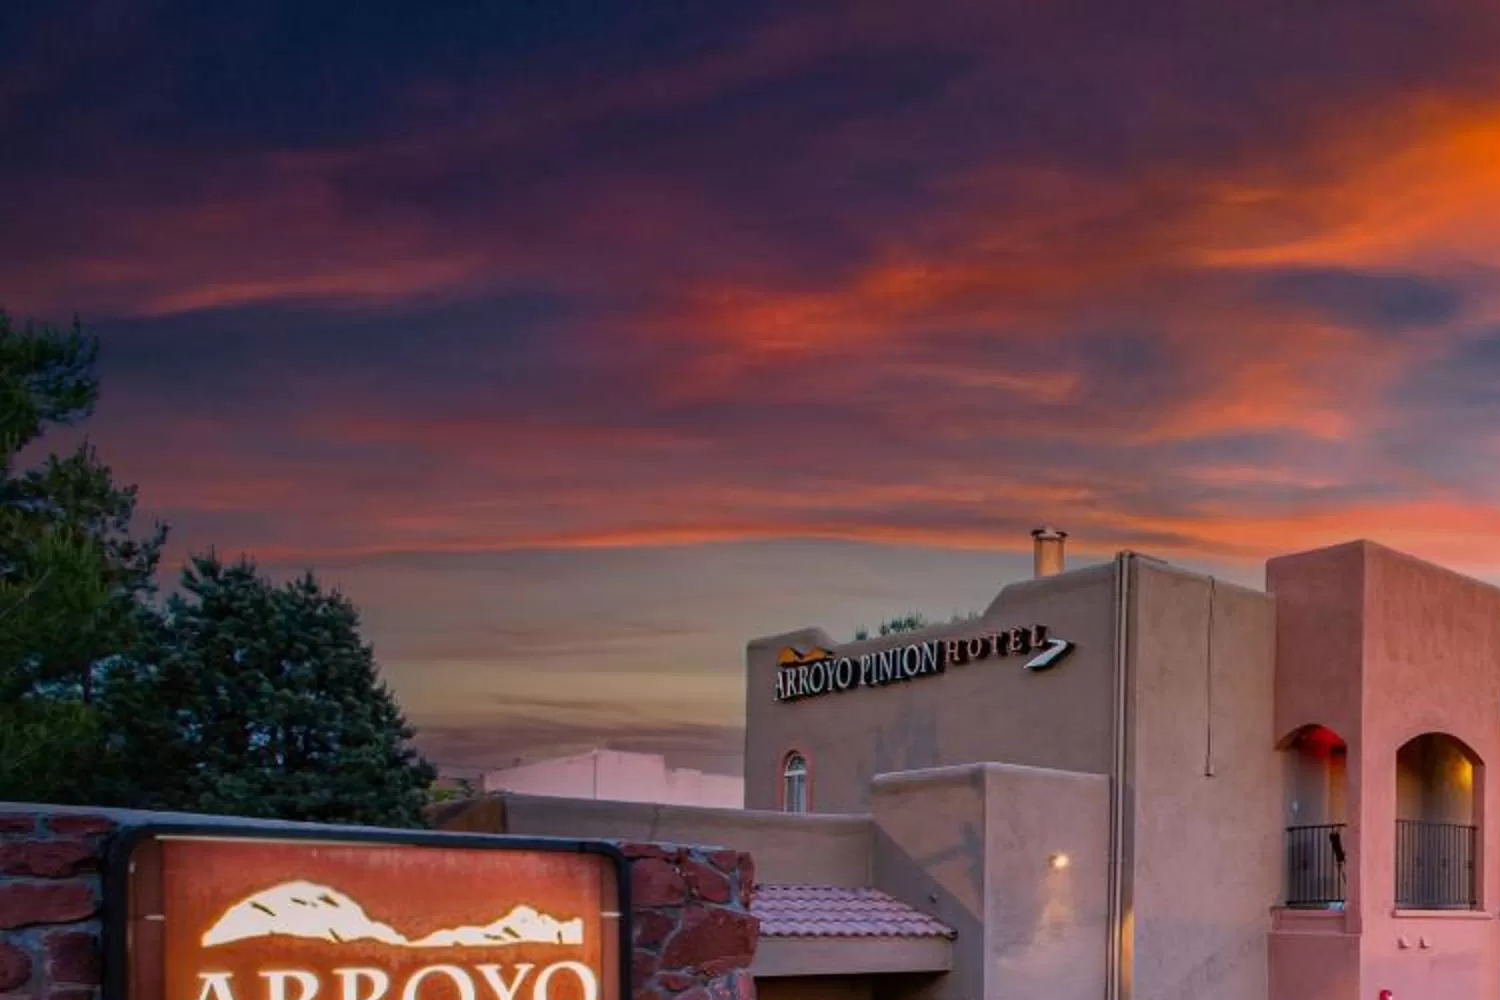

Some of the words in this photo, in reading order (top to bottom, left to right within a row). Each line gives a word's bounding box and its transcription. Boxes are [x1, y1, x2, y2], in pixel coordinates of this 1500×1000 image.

[774, 657, 853, 701] ARROYO
[859, 639, 939, 686] PINION
[945, 625, 1045, 663] HOTEL
